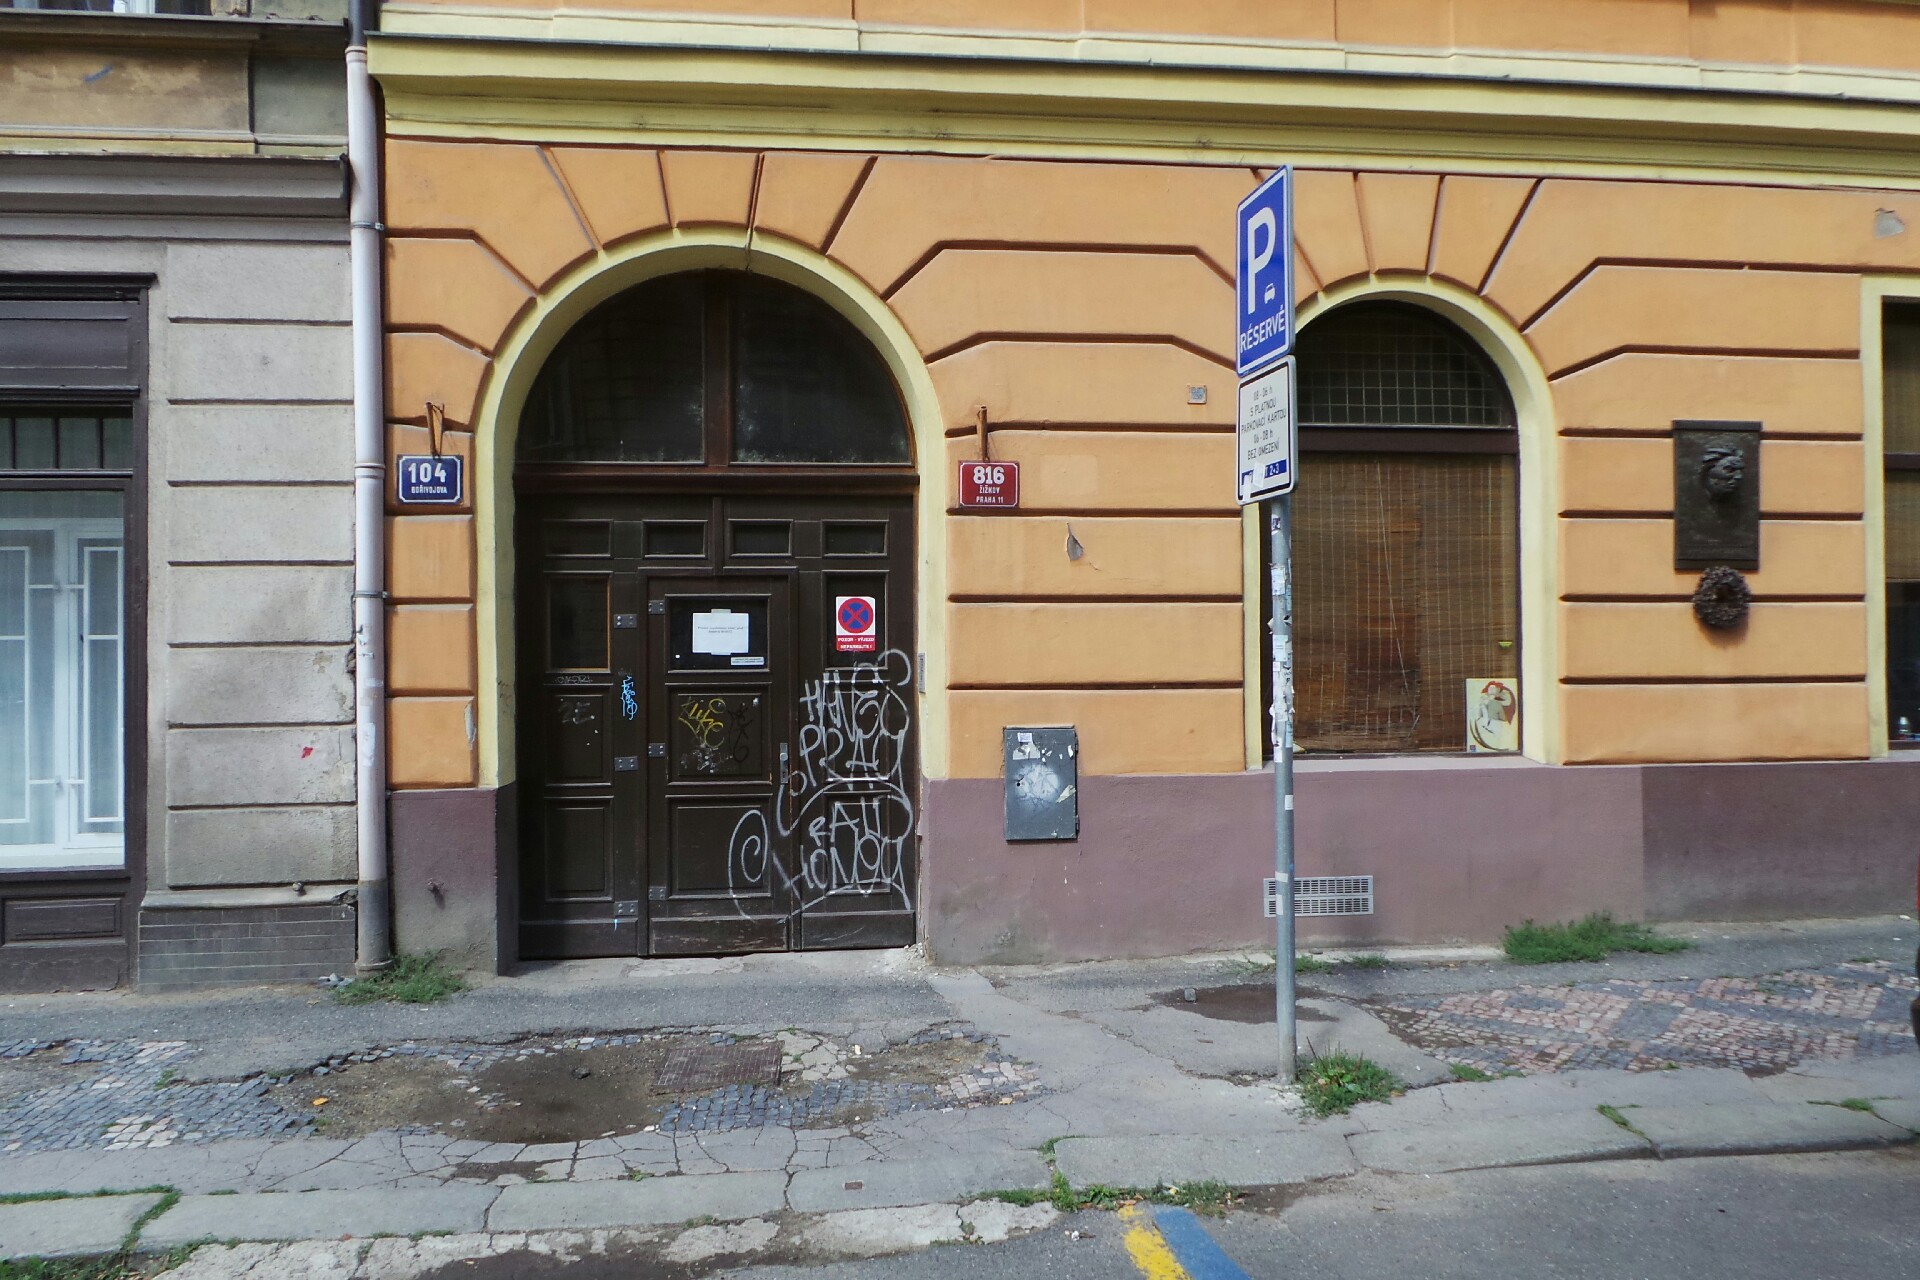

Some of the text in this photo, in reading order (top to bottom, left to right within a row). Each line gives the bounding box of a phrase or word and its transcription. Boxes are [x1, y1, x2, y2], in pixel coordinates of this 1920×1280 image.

[1247, 206, 1276, 315] P
[1240, 304, 1286, 353] RÉSERVÉ
[1255, 398, 1277, 415] PLATNOU
[1267, 408, 1287, 424] KARTOU
[1248, 447, 1257, 460] BEZ
[408, 462, 447, 484] 104
[973, 465, 1005, 485] 816
[411, 485, 448, 494] BOŘIVOJOVA
[979, 484, 1001, 494] ŽIŽKOV
[975, 496, 996, 504] PRAHA
